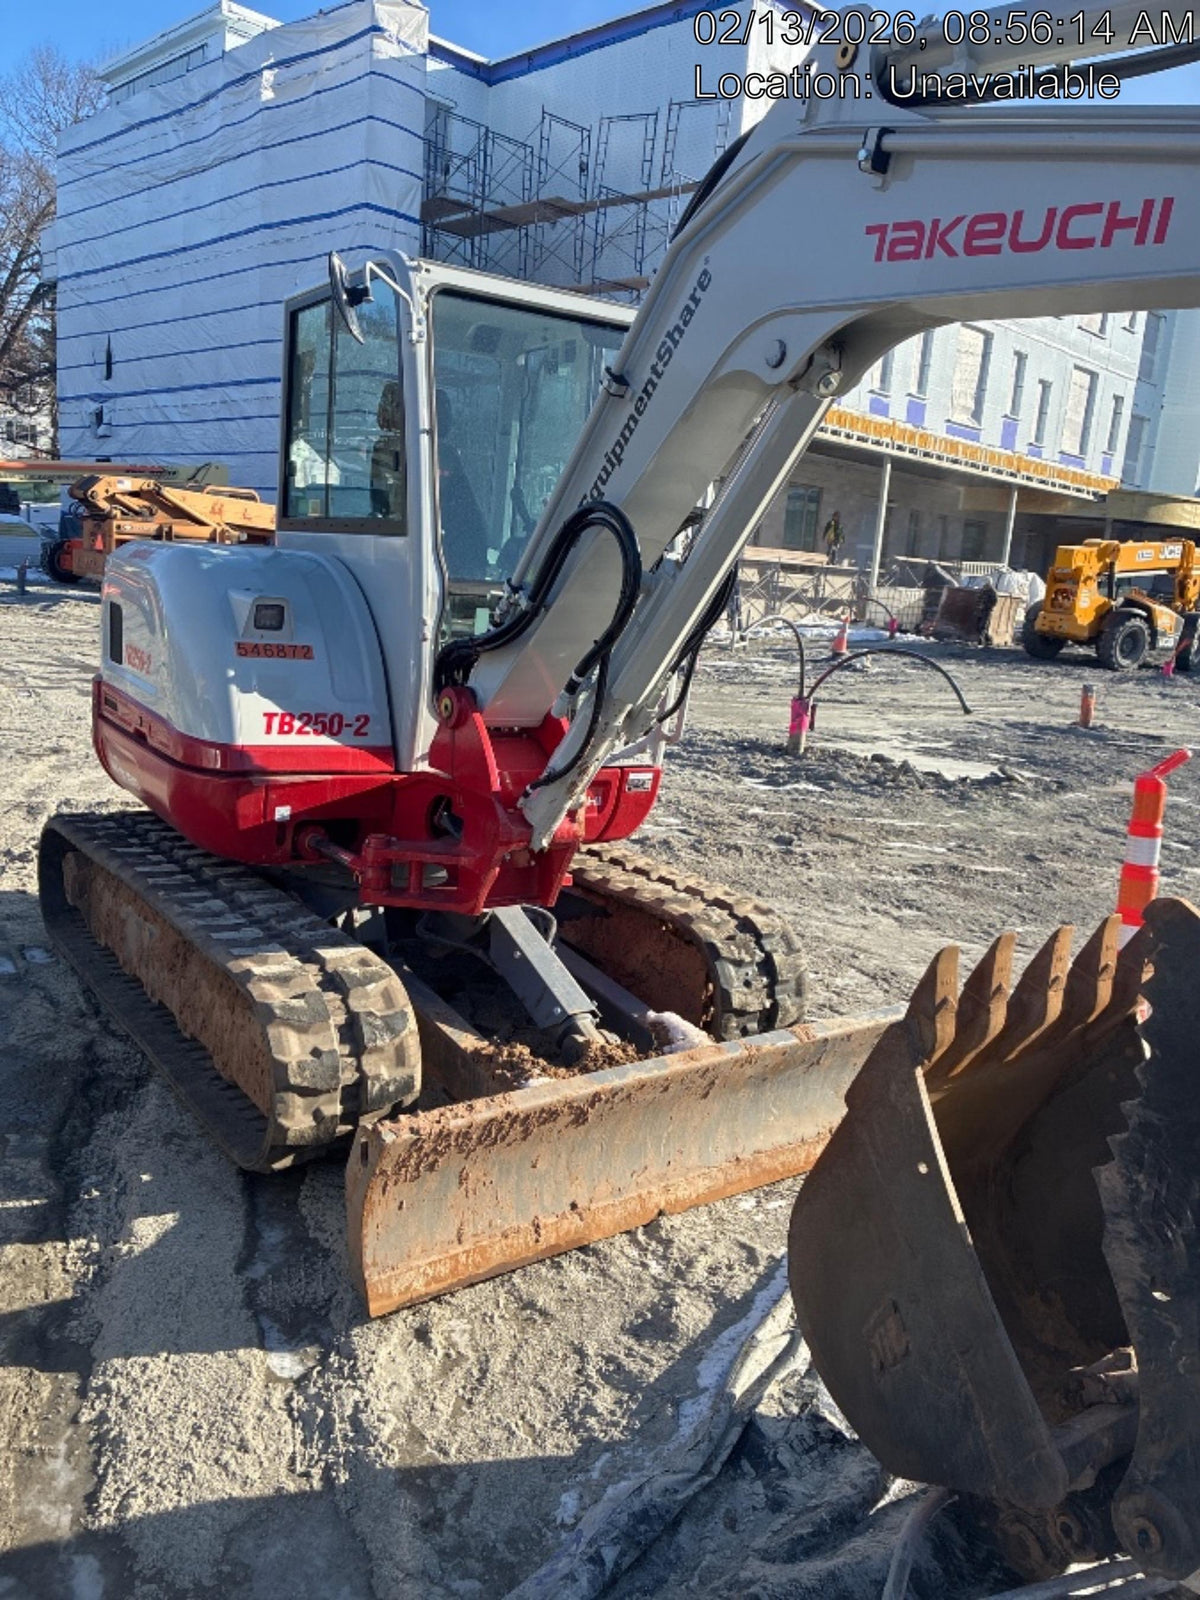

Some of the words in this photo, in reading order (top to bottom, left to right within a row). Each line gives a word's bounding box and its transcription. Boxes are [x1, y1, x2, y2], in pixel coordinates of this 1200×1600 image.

[865, 197, 1176, 263] TAKEUCHI
[237, 642, 312, 660] 546872
[262, 712, 371, 737] TB250-2
